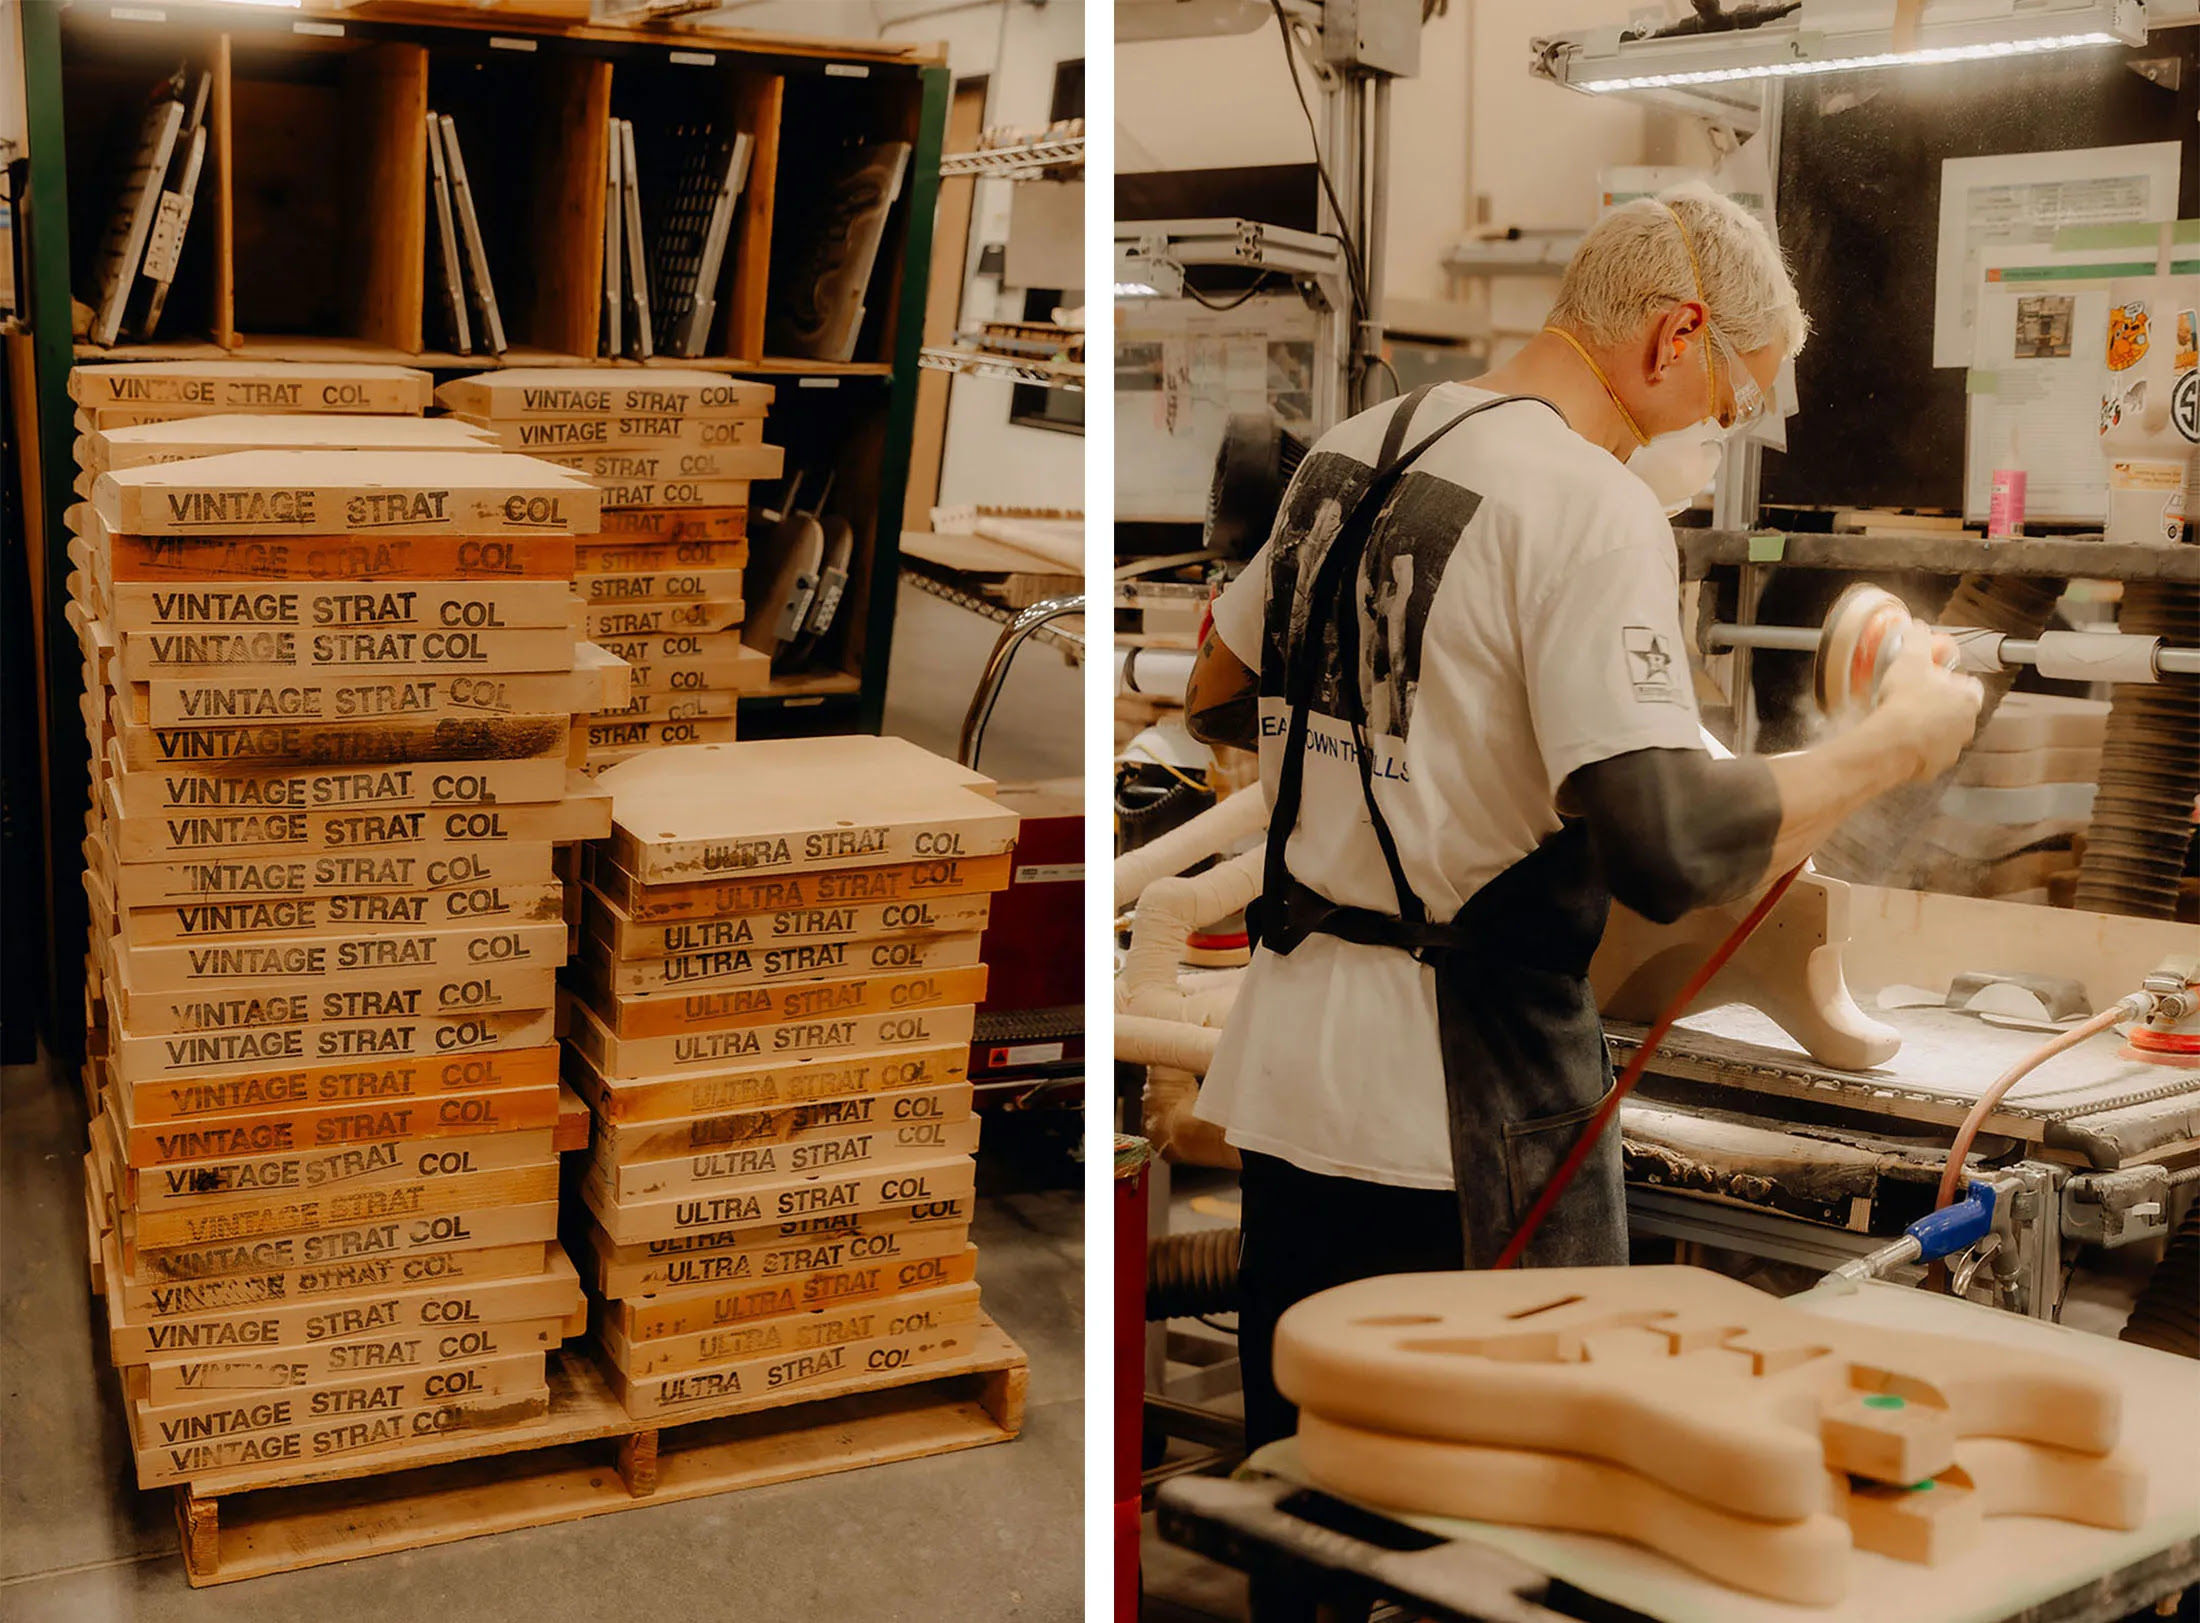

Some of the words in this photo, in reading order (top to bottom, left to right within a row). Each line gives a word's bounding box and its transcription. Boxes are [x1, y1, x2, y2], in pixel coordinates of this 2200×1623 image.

[323, 385, 370, 405] COL
[523, 390, 610, 409] VINTAGE
[626, 391, 689, 412] STRAT
[701, 387, 739, 405] COL
[520, 422, 607, 444] VINTAGE
[620, 418, 683, 434] STRAT
[701, 422, 744, 443] COL
[595, 457, 658, 476] STRAT
[680, 456, 719, 473] COL
[168, 492, 315, 522] VINTAGE
[346, 492, 449, 525] STRAT
[502, 496, 568, 524] COL
[664, 485, 703, 502] COL
[458, 542, 523, 571] COL
[592, 578, 655, 596] STRAT
[666, 578, 706, 594] COL
[153, 595, 298, 621] VINTAGE
[312, 593, 417, 624] STRAT
[440, 601, 504, 627] COL
[600, 612, 662, 633] STRAT
[151, 633, 296, 662] VINTAGE
[312, 634, 416, 661] STRAT
[421, 634, 488, 660] COL
[663, 639, 702, 654] COL
[179, 688, 321, 716] VINTAGE
[335, 683, 436, 714] STRAT
[450, 678, 510, 709] COL
[671, 673, 709, 688] COL
[157, 730, 299, 758] VINTAGE
[589, 726, 650, 745] STRAT
[662, 724, 699, 741] COL
[1262, 717, 1288, 736] EA
[1306, 729, 1338, 758] OWN
[1340, 740, 1358, 762] TH
[1373, 754, 1410, 782] LLS
[166, 779, 306, 804] VINTAGE
[312, 772, 414, 801] STRAT
[433, 776, 496, 801] COL
[167, 815, 308, 846] VINTAGE
[325, 813, 425, 845] STRAT
[445, 814, 507, 838] COL
[703, 838, 791, 870] ULTRA
[805, 829, 889, 858] STRAT
[915, 833, 965, 856] COL
[167, 865, 305, 891] INTAGE
[314, 859, 415, 884] STRAT
[427, 855, 490, 885] COL
[716, 883, 804, 911] ULTRA
[817, 874, 902, 899] STRAT
[910, 863, 963, 886] COL
[177, 901, 315, 932] VINTAGE
[328, 896, 428, 921] STRAT
[446, 889, 509, 915] COL
[665, 920, 753, 950] ULTRA
[772, 910, 858, 935] STRAT
[882, 904, 934, 926] COL
[189, 948, 325, 975] VINTAGE
[337, 938, 436, 966] STRAT
[467, 934, 530, 961] COL
[664, 951, 751, 981] ULTRA
[765, 943, 848, 973] STRAT
[871, 945, 922, 966] COL
[172, 995, 308, 1029] VINTAGE
[323, 990, 421, 1016] STRAT
[439, 980, 502, 1006] COL
[685, 989, 771, 1017] ULTRA
[784, 982, 866, 1016] STRAT
[890, 979, 942, 1005] COL
[165, 1031, 302, 1065] VINTAGE
[318, 1027, 416, 1054] STRAT
[435, 1021, 497, 1049] COL
[675, 1032, 760, 1060] ULTRA
[773, 1023, 856, 1048] STRAT
[879, 1018, 929, 1041] COL
[171, 1074, 307, 1113] VINTAGE
[319, 1070, 416, 1098] STRAT
[441, 1062, 501, 1086] COL
[881, 1061, 932, 1086] COL
[894, 1097, 943, 1118] COL
[156, 1124, 293, 1160] VINTAGE
[315, 1111, 413, 1142] STRAT
[439, 1100, 498, 1122] COL
[306, 1143, 402, 1184] STRAT
[419, 1152, 477, 1176] COL
[693, 1148, 776, 1177] ULTRA
[792, 1136, 872, 1167] STRAT
[898, 1124, 945, 1144] COL
[675, 1198, 761, 1225] ULTRA
[778, 1183, 860, 1213] STRAT
[881, 1178, 931, 1199] COL
[911, 1201, 961, 1219] COL
[305, 1225, 399, 1261] STRAT
[410, 1216, 470, 1243] COL
[403, 1256, 463, 1279] COL
[667, 1255, 751, 1282] ULTRA
[761, 1245, 844, 1273] STRAT
[850, 1235, 900, 1256] COL
[715, 1289, 796, 1319] ULTRA
[804, 1270, 880, 1300] STRAT
[899, 1258, 947, 1285] COL
[148, 1321, 279, 1348] VINTAGE
[306, 1301, 399, 1339] STRAT
[421, 1301, 479, 1322] COL
[890, 1312, 941, 1335] COL
[328, 1340, 421, 1369] STRAT
[439, 1331, 496, 1357] COL
[657, 1371, 742, 1402] ULTRA
[768, 1347, 845, 1386] STRAT
[160, 1402, 291, 1442] VINTAGE
[311, 1386, 404, 1413] STRAT
[424, 1371, 483, 1396] COL
[313, 1416, 404, 1454] STRAT
